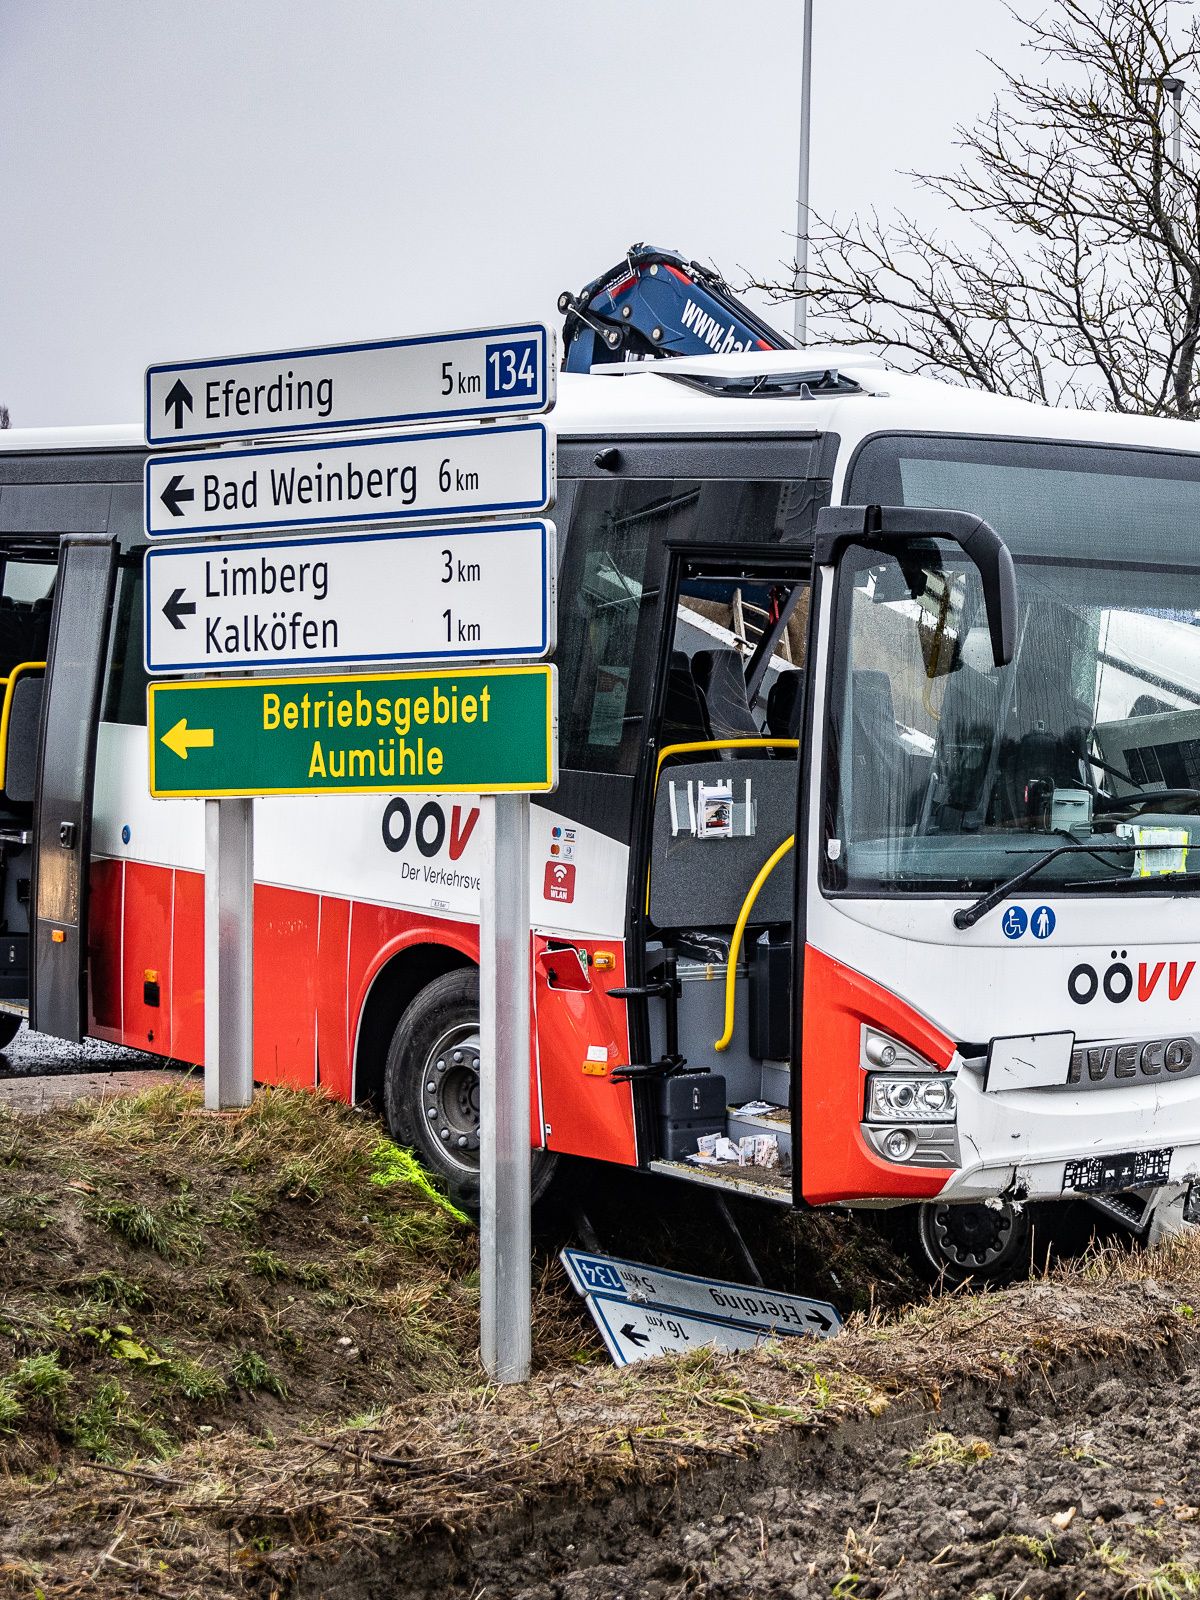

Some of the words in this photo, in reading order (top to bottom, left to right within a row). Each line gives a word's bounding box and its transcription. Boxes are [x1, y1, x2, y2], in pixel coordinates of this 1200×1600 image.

[205, 371, 334, 418] Eferding
[441, 362, 454, 396] 5
[458, 371, 481, 394] km
[488, 348, 535, 392] 134
[204, 471, 258, 512] Bad
[271, 462, 417, 505] Weinberg
[438, 458, 451, 492] 6
[455, 469, 479, 491] km
[205, 557, 329, 600] Limberg
[441, 549, 453, 583] 3
[457, 560, 481, 582] km
[205, 612, 339, 654] Kalköfen
[442, 608, 452, 643] 1
[458, 620, 481, 642] km
[263, 684, 491, 736] Betriebsgebiet
[308, 738, 444, 778] Aumühle
[401, 862, 421, 881] Der
[1067, 949, 1197, 1005] OÖVV
[1070, 1039, 1193, 1084] IVECO
[582, 1263, 622, 1288] 134
[642, 1276, 656, 1293] 5
[645, 1314, 667, 1331] km
[709, 1288, 803, 1325] Eferding
[668, 1320, 689, 1340] 16
